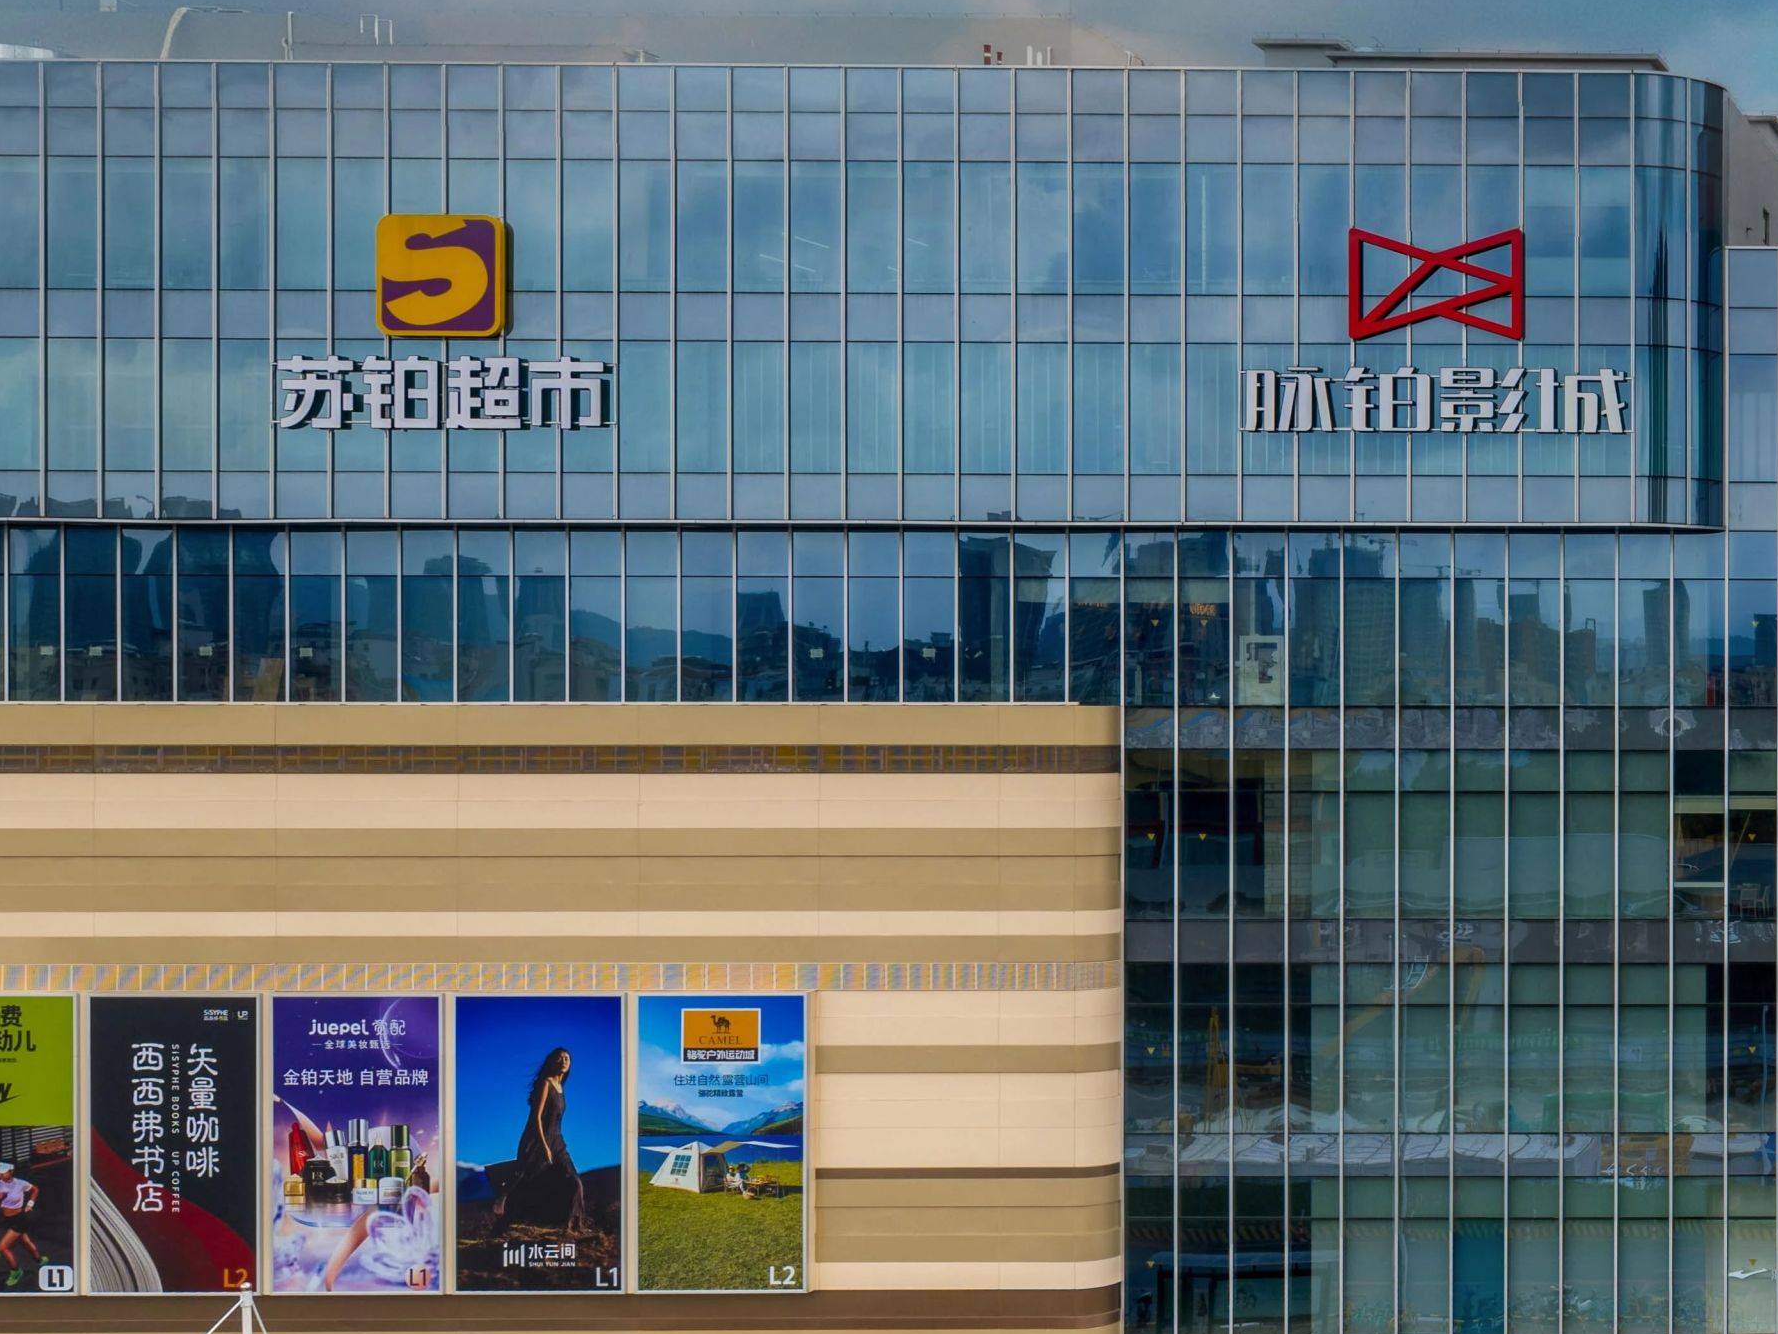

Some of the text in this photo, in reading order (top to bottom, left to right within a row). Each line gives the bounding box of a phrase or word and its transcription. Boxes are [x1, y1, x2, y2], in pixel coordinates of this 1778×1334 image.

[276, 355, 604, 429] 苏铂超市
[1245, 367, 1627, 433] 脉铂影城
[308, 1019, 369, 1036] juepei
[699, 1036, 742, 1045] CAMEL
[283, 1068, 429, 1086] 金铂天地 自营品牌
[171, 1096, 180, 1134] BOOKS
[186, 1043, 220, 1178] 矢量咖啡
[131, 1042, 165, 1213] 西西弗书店
[171, 1171, 181, 1214] COFFEE
[528, 1244, 576, 1260] 水云间
[47, 1269, 65, 1287] L1
[223, 1268, 247, 1288] L2
[408, 1269, 429, 1287] L1
[596, 1268, 618, 1286] L1
[770, 1266, 795, 1284] L2
